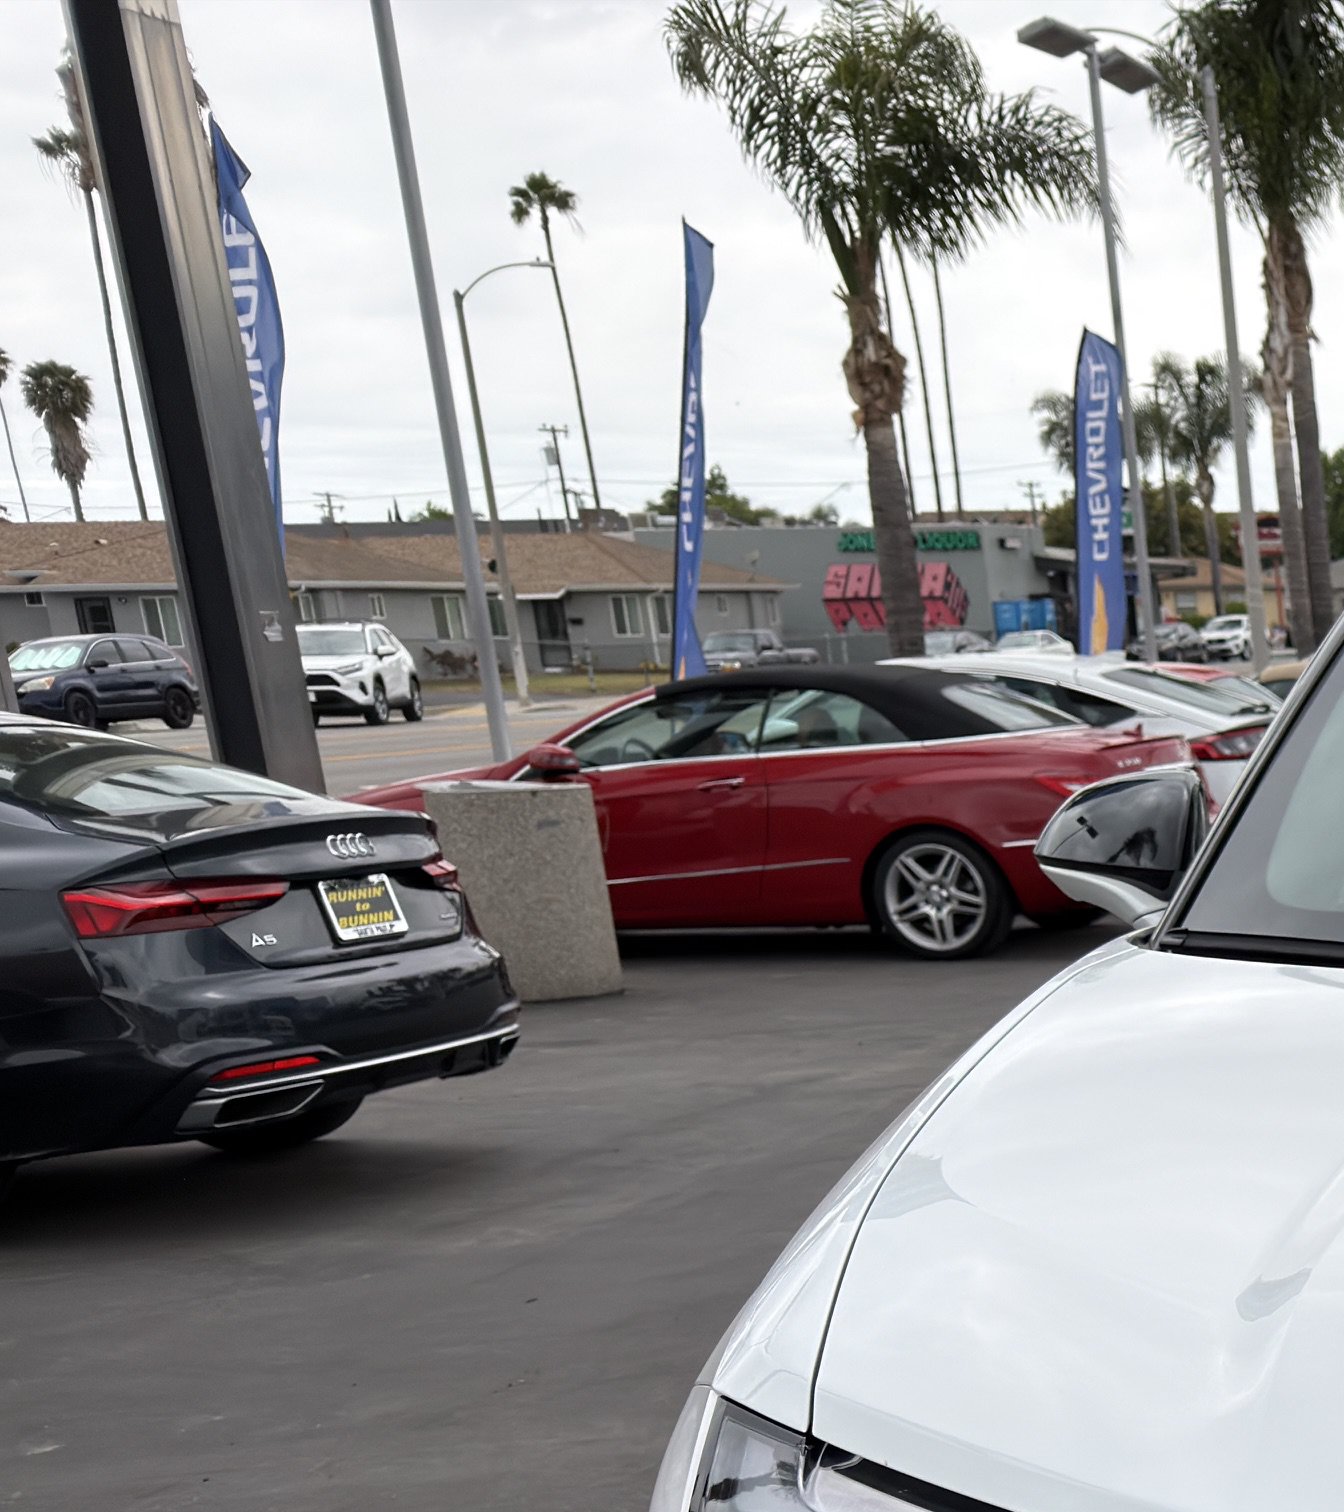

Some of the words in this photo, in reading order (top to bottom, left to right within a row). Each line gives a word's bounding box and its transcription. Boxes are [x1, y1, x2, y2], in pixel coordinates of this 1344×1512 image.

[1085, 355, 1111, 562] CHEVROLET
[355, 902, 370, 912] to
[339, 909, 394, 929] BUNNIN
[251, 932, 278, 948] A5
